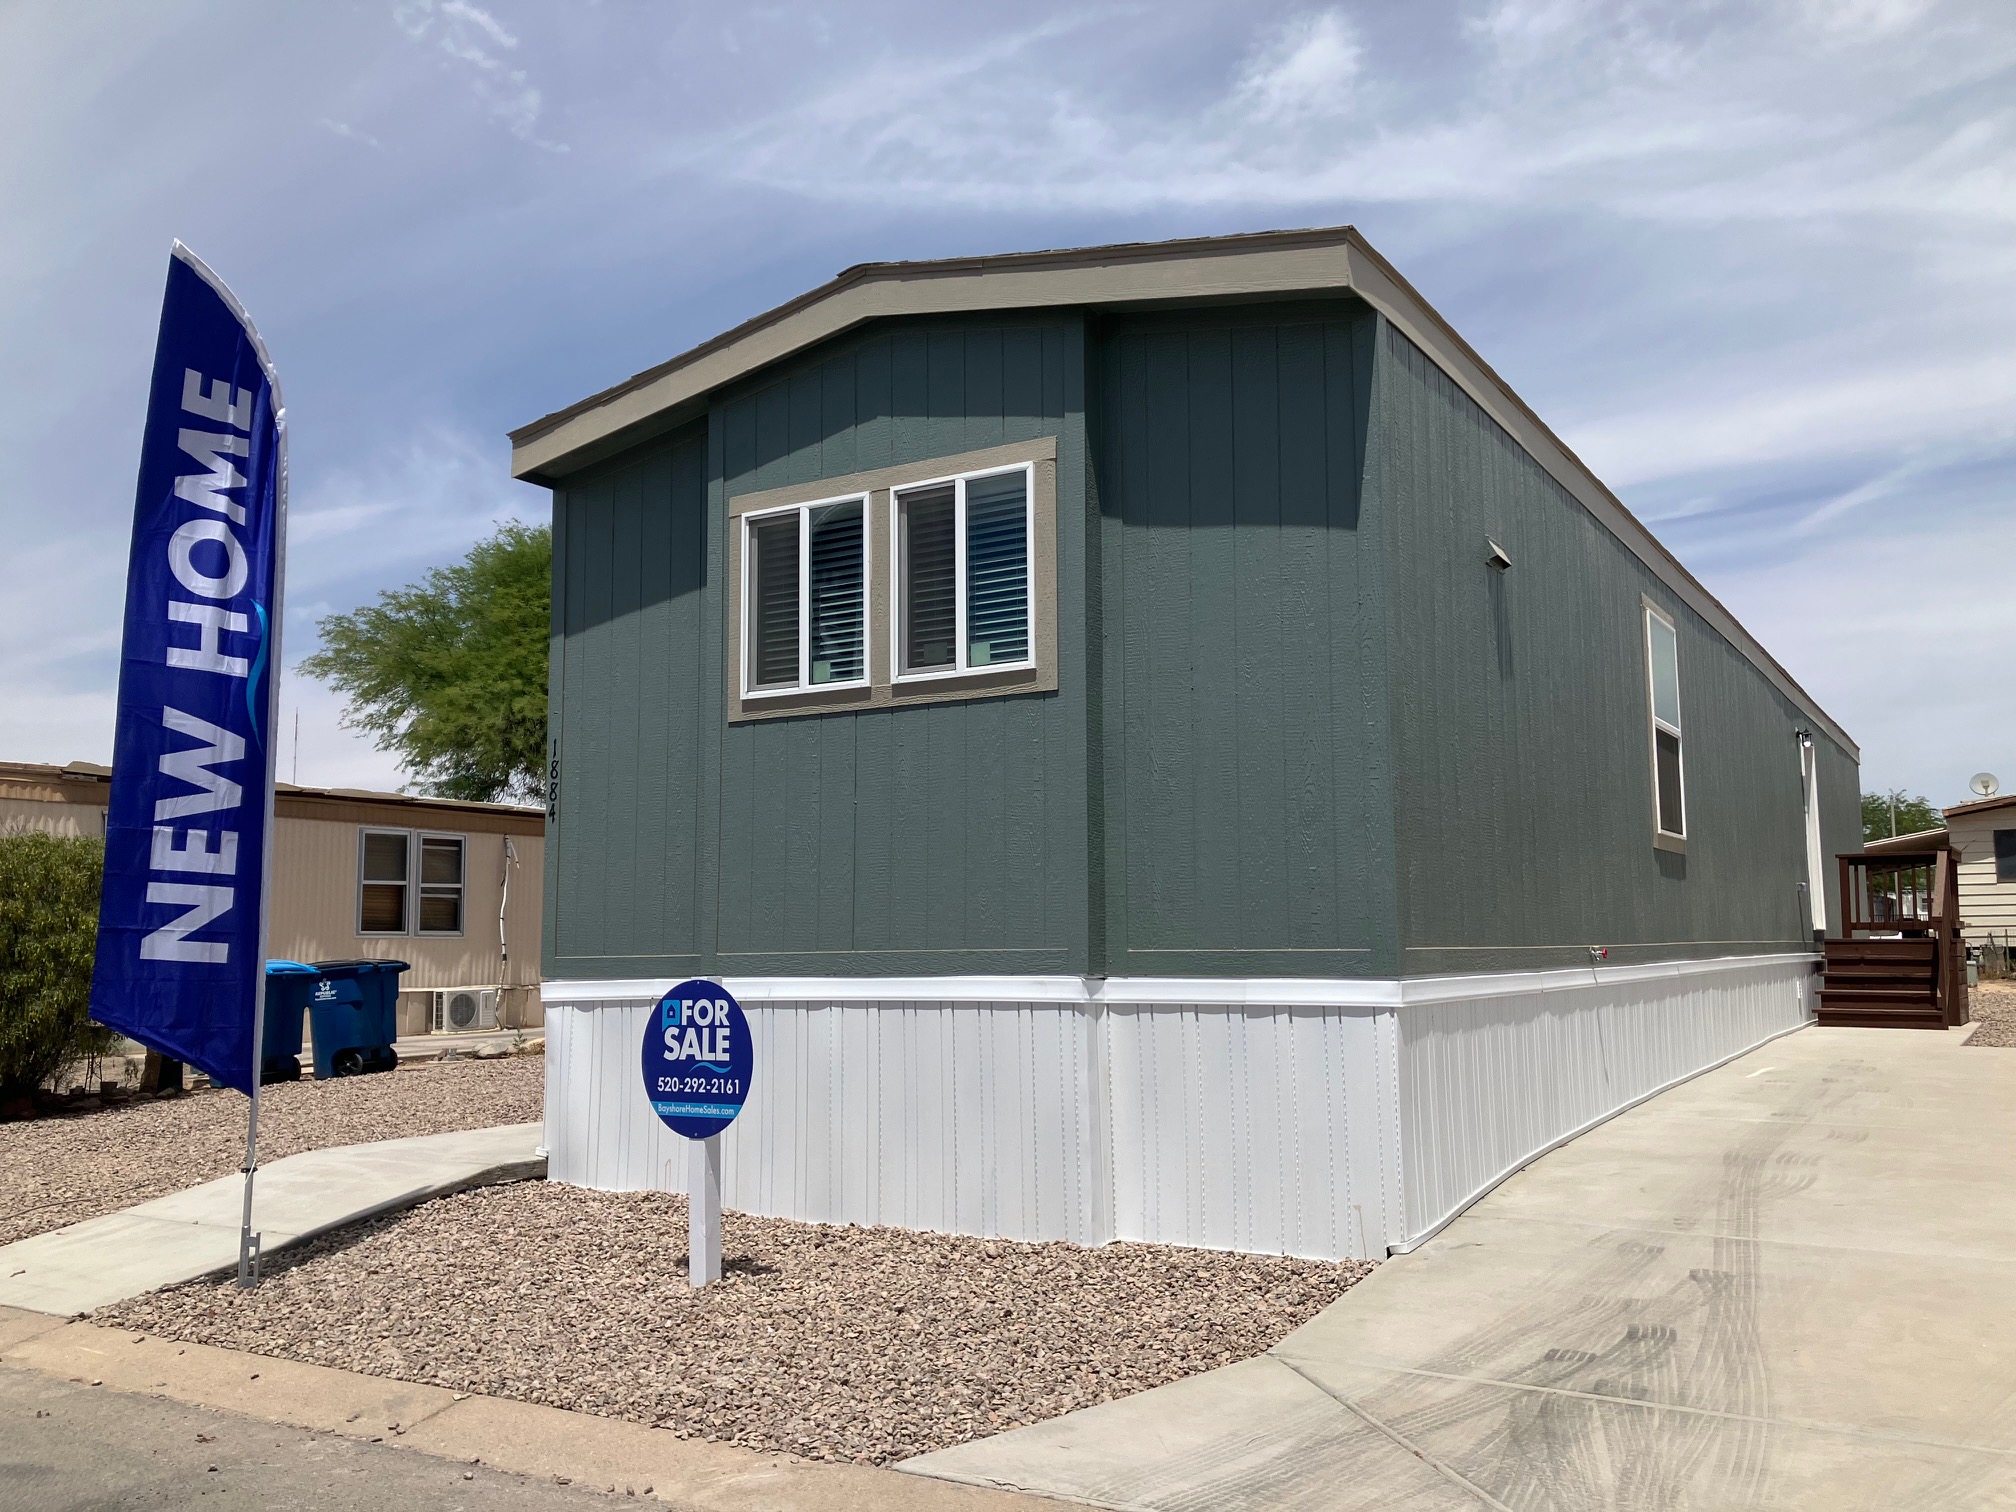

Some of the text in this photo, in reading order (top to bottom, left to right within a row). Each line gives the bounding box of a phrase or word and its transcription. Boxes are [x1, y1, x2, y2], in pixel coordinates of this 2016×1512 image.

[139, 367, 252, 963] NEW HOME
[548, 738, 559, 824] 1884
[681, 999, 730, 1026] FOR
[663, 1027, 730, 1061] SALE
[657, 1077, 740, 1094] 520-292-2161
[658, 1104, 734, 1115] BayshoreHomeSales.com
